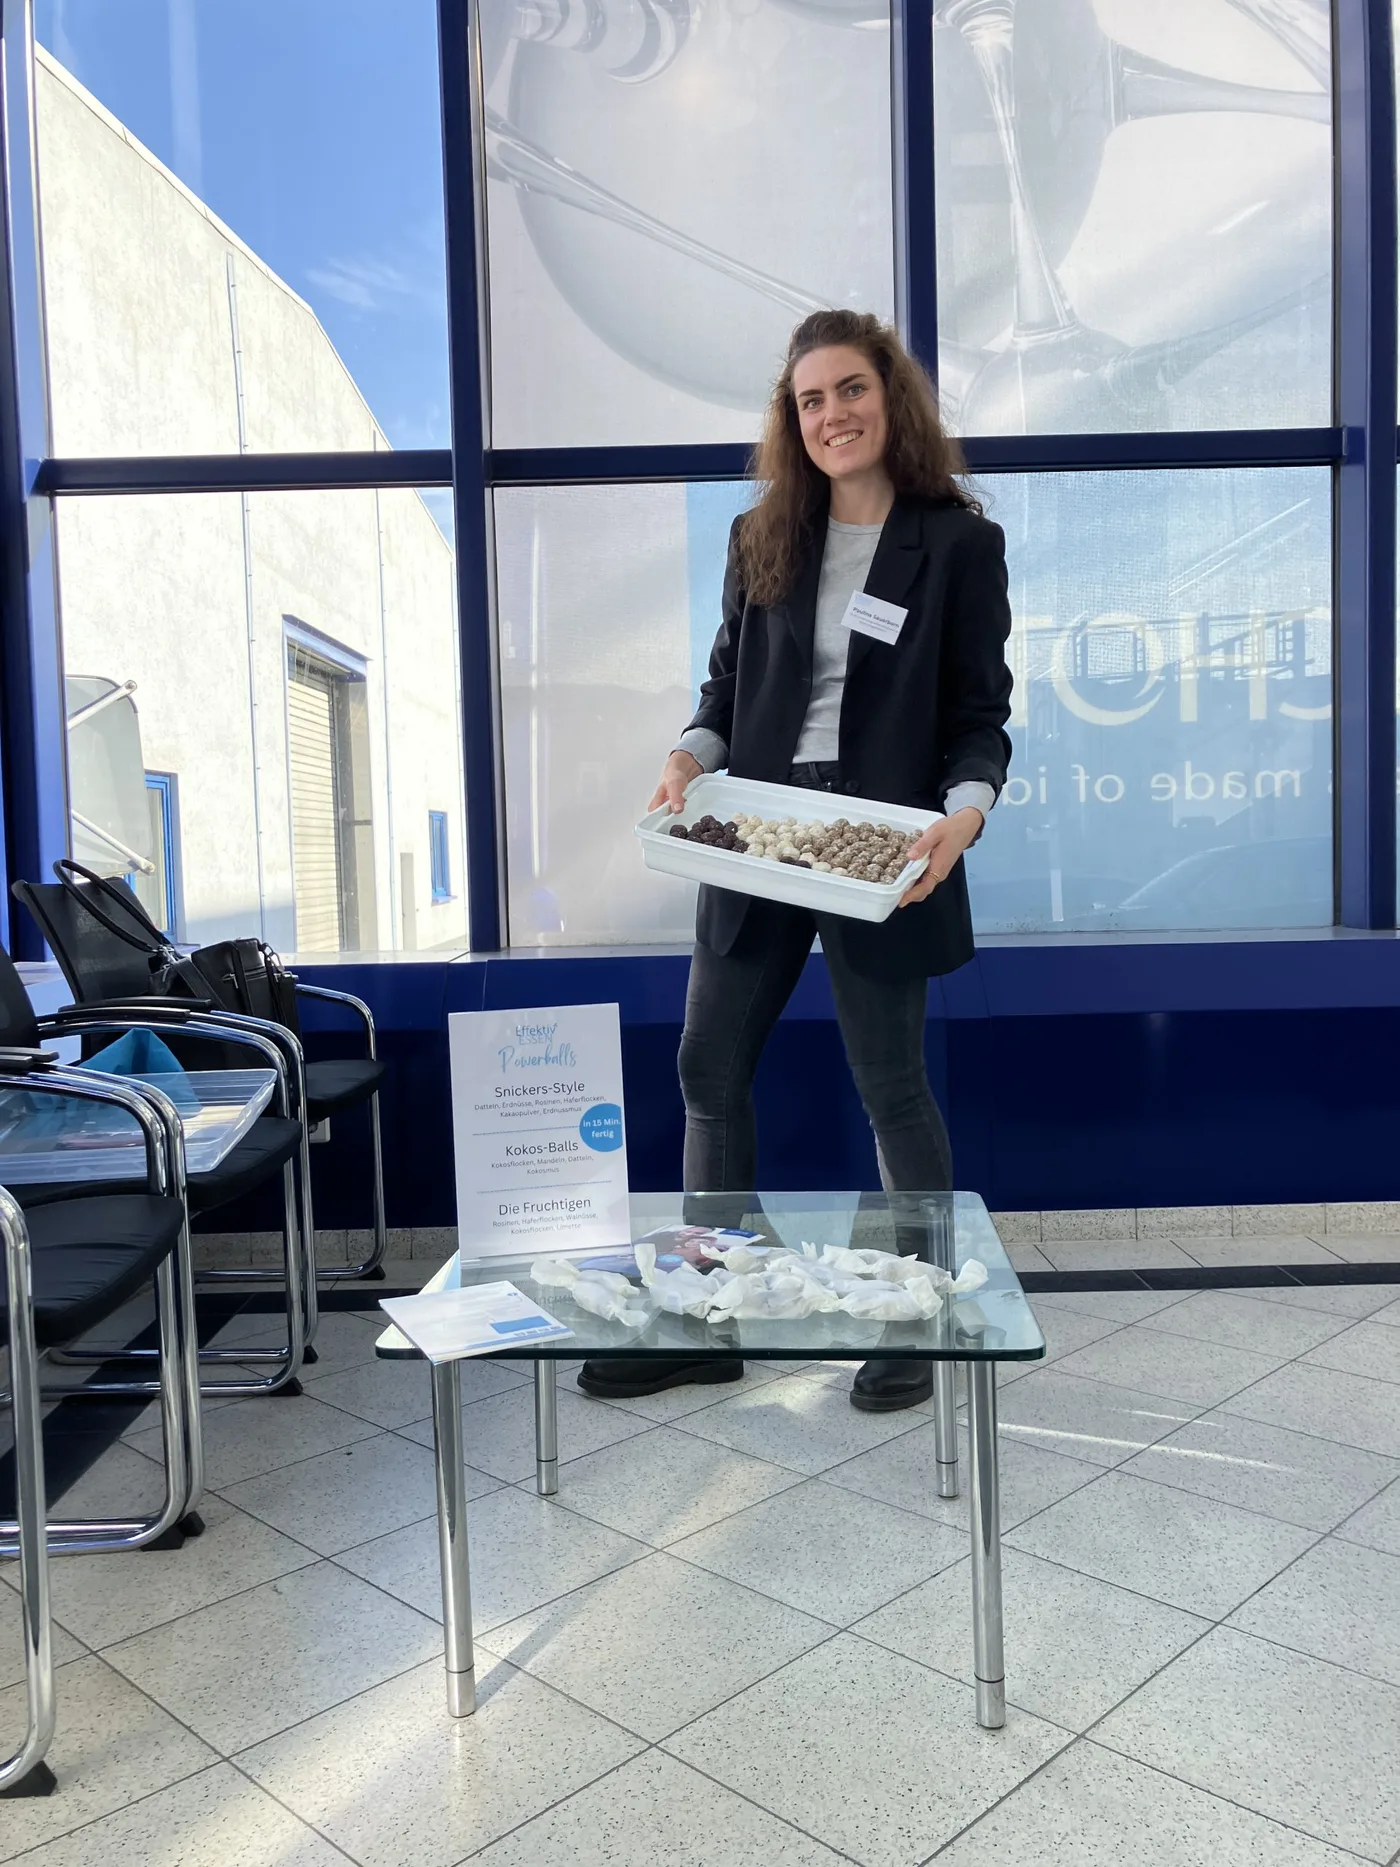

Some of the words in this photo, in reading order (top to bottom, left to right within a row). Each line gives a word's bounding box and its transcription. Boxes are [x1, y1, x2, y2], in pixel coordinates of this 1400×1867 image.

[518, 1035, 553, 1046] ESSEN
[498, 1042, 578, 1073] Powerballs
[494, 1080, 585, 1098] Snickers-Style
[474, 1103, 501, 1111] Datteln,
[501, 1100, 534, 1109] Erdnüsse,
[534, 1098, 563, 1107] Rosinen,
[542, 1106, 582, 1115] Erdnussmus
[592, 1118, 602, 1127] 15
[591, 1128, 615, 1139] fertig
[505, 1140, 579, 1157] Kokos-Balls
[491, 1160, 536, 1169] Kokosflocken,
[526, 1166, 560, 1175] Kokosmus
[498, 1203, 520, 1216] Die
[522, 1197, 592, 1214] Fruchtigen
[492, 1219, 521, 1228] Rosinen,
